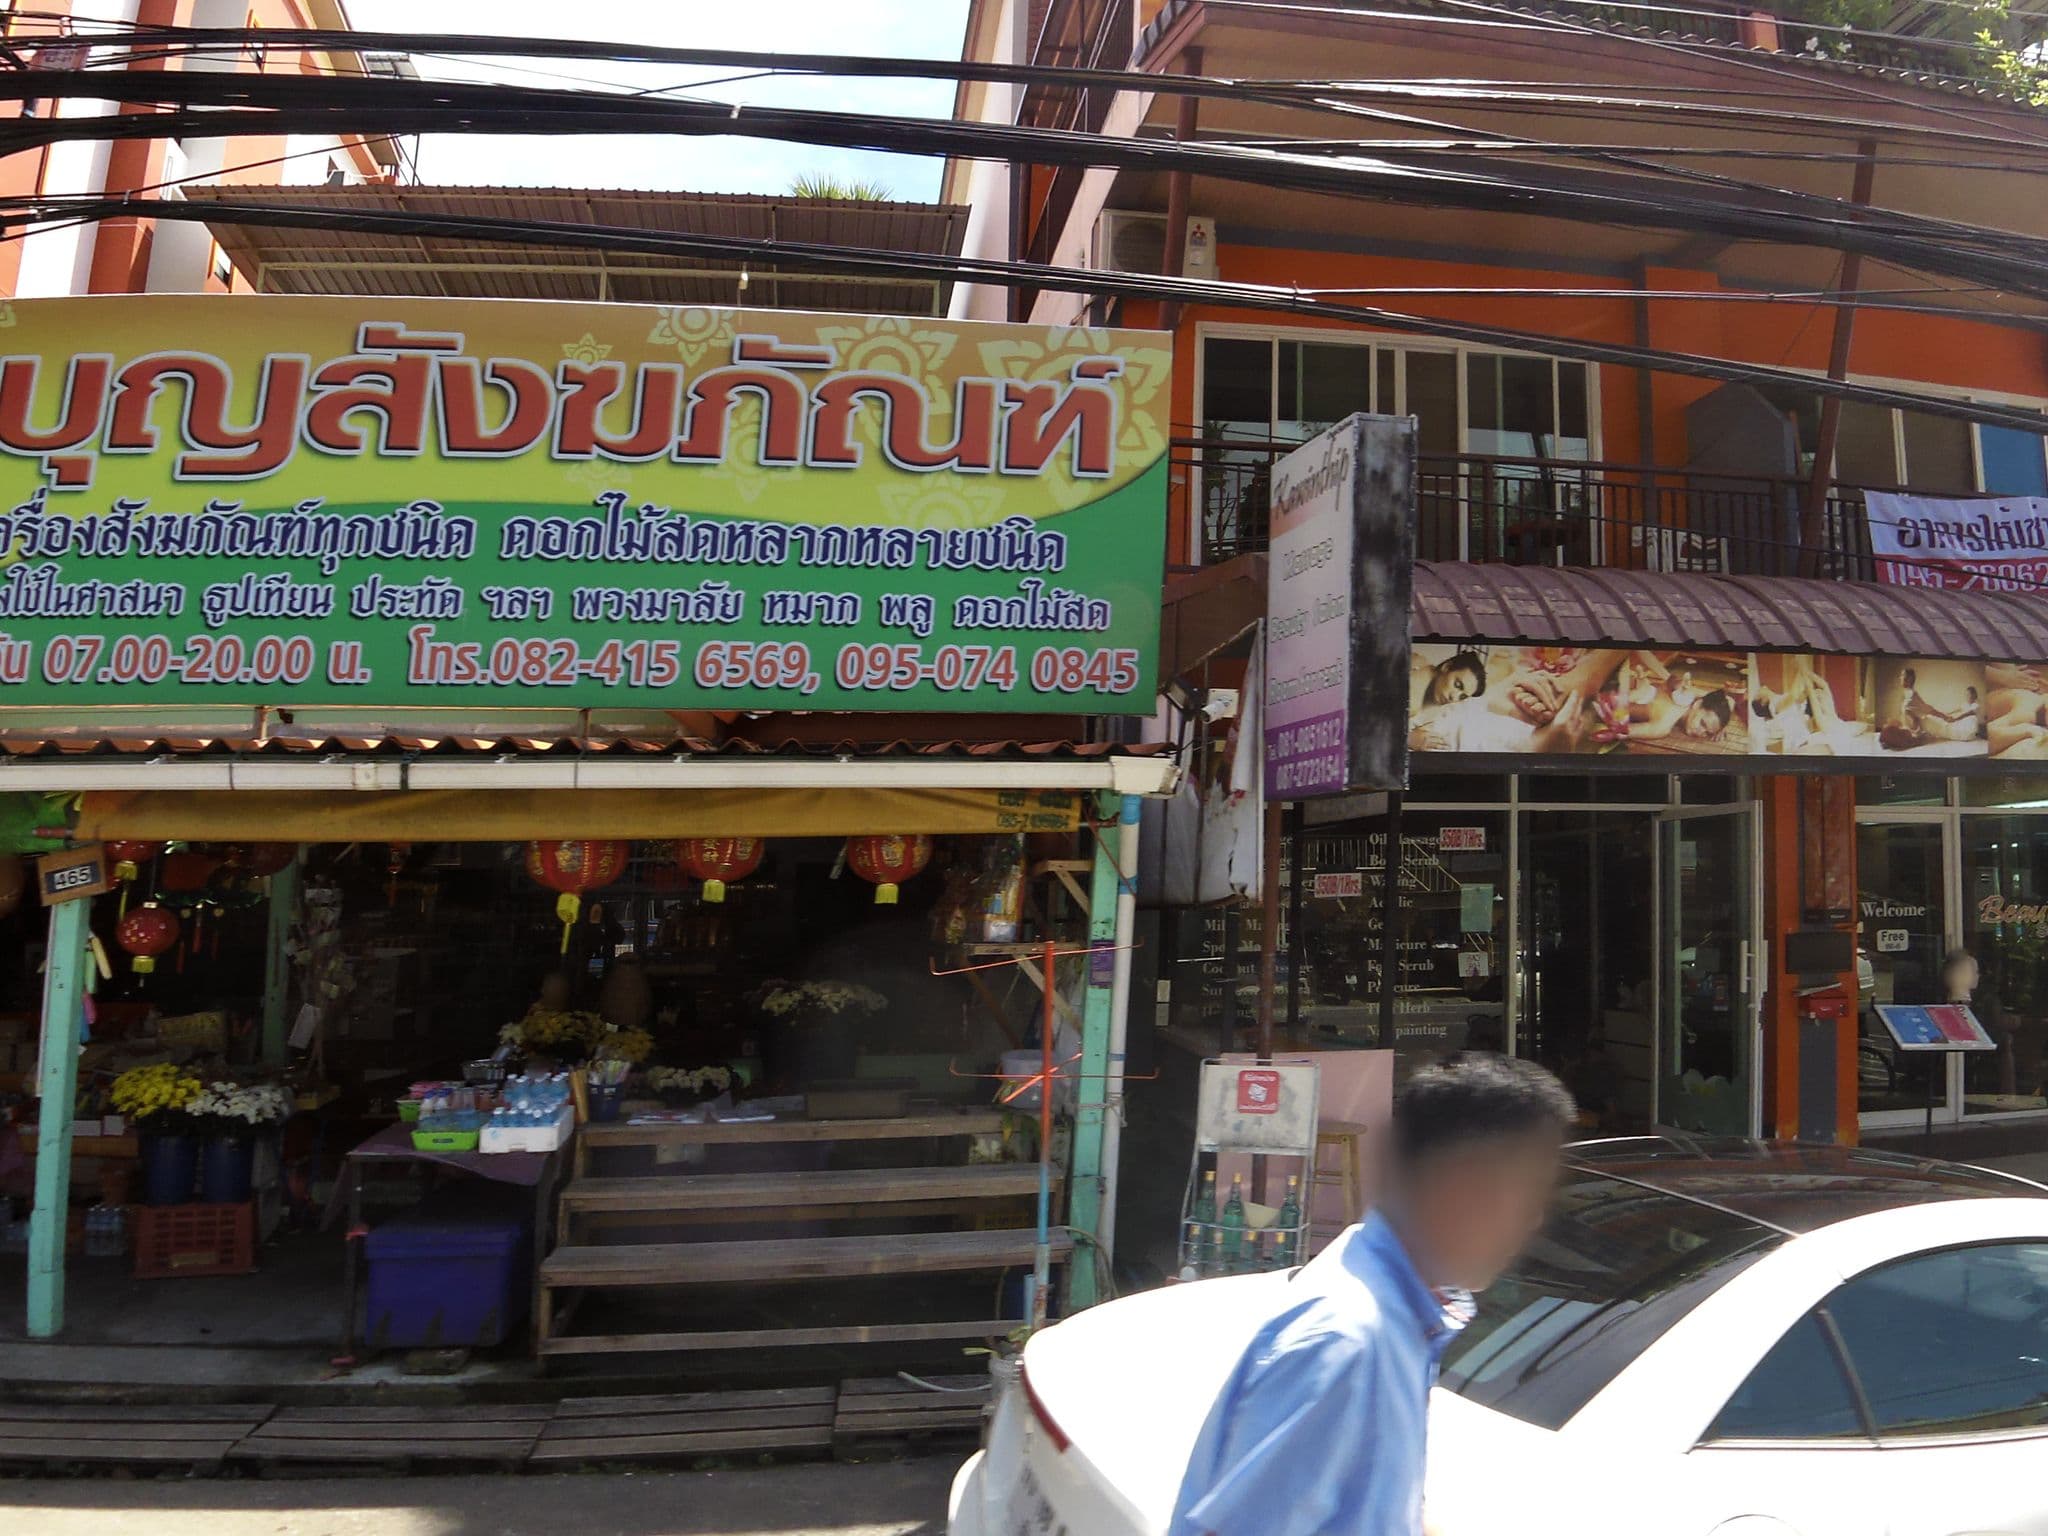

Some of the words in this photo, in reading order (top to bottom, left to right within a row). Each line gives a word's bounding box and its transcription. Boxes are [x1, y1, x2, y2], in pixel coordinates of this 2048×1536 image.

[0, 322, 1124, 489] บุญสังฆภัณฑ์
[500, 490, 1067, 571] ดอกไม้สดหลากหลายชนิด
[203, 572, 334, 627] ธูปเทียน
[483, 586, 552, 619] ฯลฯ
[573, 580, 744, 623] พวงมาลัย
[763, 590, 861, 624] หมาก
[881, 593, 934, 636] พลู
[954, 577, 1110, 630] ดอกไม้สด
[43, 634, 314, 683] 07.00-20.00
[328, 641, 371, 684] น.
[408, 624, 681, 687] โทร.082-415
[696, 641, 820, 693] 6569,
[836, 644, 1018, 691] 095-074
[1032, 647, 1138, 693] 0845
[1369, 833, 1387, 845] Oil
[1404, 854, 1440, 866] Scrub
[55, 866, 91, 889] 465
[1861, 900, 1926, 917] Welcome
[1881, 931, 1905, 942] Free
[1398, 959, 1434, 971] Scrub
[1395, 1023, 1447, 1039] painting
